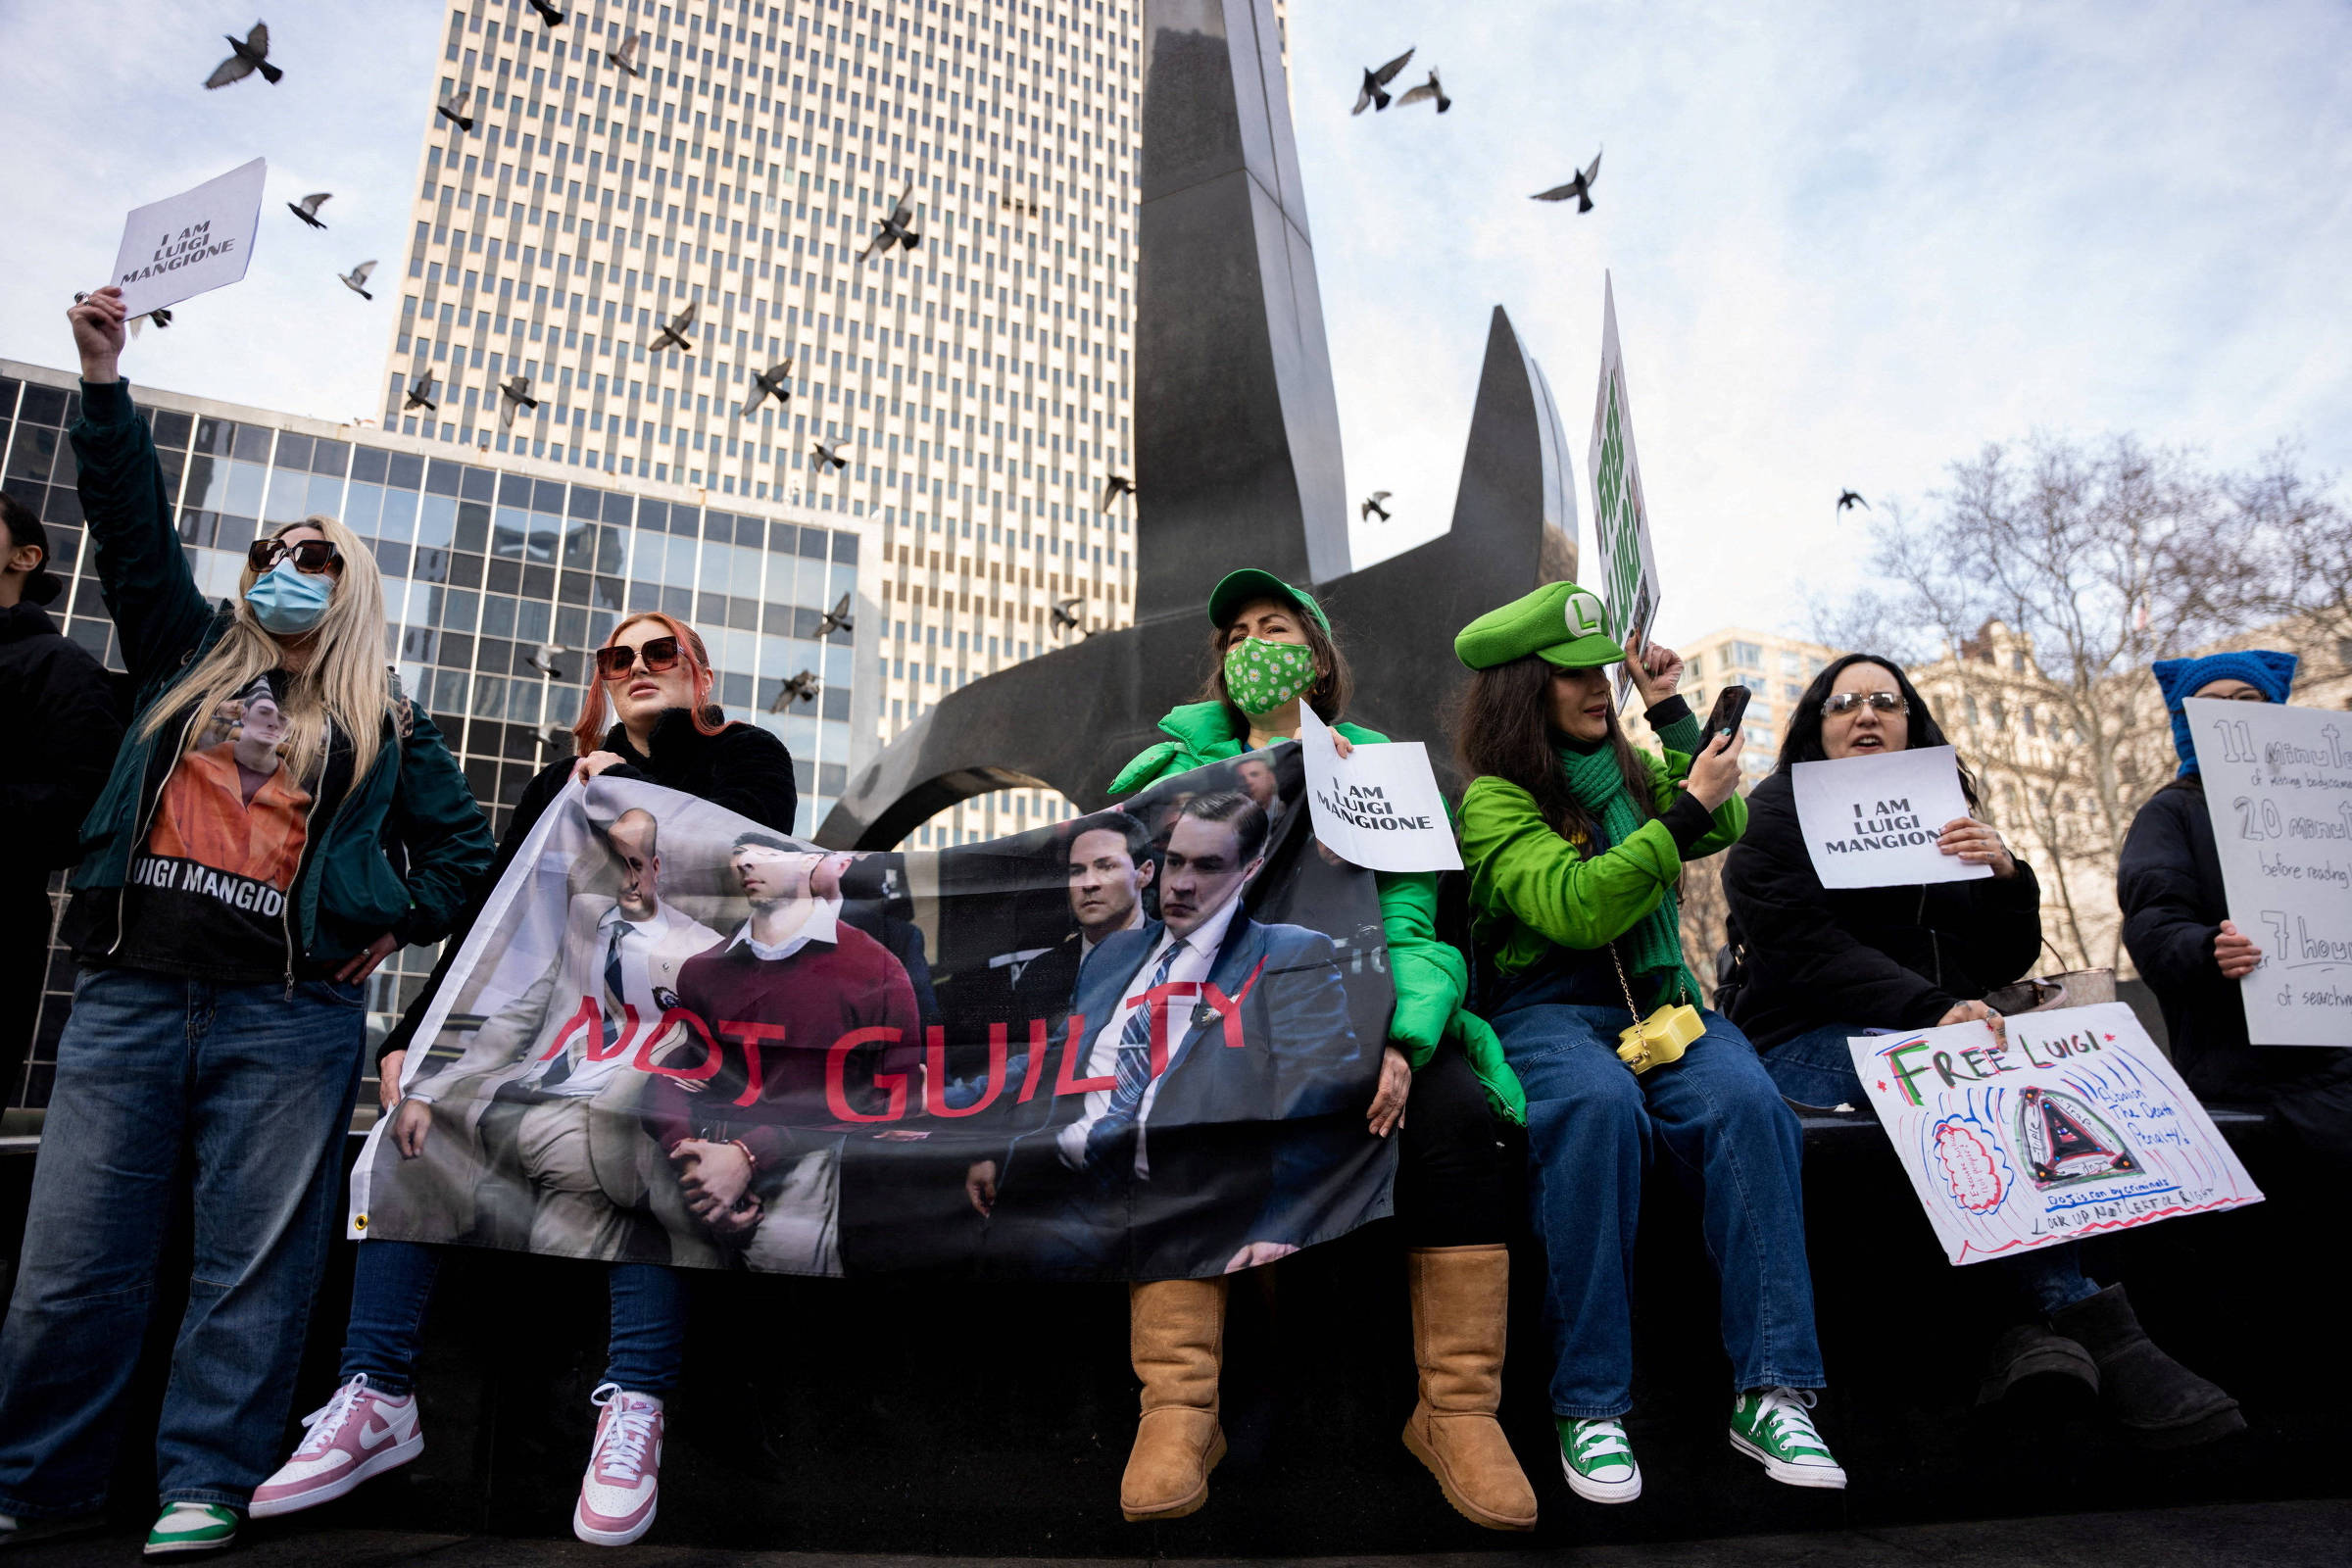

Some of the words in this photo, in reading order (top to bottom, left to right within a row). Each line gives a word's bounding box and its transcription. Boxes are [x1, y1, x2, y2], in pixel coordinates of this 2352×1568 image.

[153, 233, 210, 262] LUIGI
[161, 234, 170, 246] I
[177, 220, 211, 241] AM
[120, 238, 236, 287] MANGIONE
[1597, 368, 1625, 557] FREE
[1608, 473, 1642, 650] LUIGI
[1572, 600, 1596, 629] L
[2213, 719, 2257, 762] 11
[1333, 776, 1340, 791] I
[1349, 785, 1385, 800] AM
[2251, 767, 2262, 786] of
[1316, 790, 1434, 831] MANGIONE
[1333, 790, 1394, 815] LUIGI
[1853, 804, 1863, 818] I
[1875, 798, 1911, 816] AM
[2233, 796, 2282, 841] 20
[1853, 814, 1921, 835] LUIGI
[1825, 828, 1942, 855] MANGION
[2259, 851, 2302, 878] before
[2307, 859, 2349, 889] reading
[133, 858, 178, 888] UIGI
[182, 862, 286, 918] MANGIO
[2261, 910, 2289, 960] 7
[2278, 984, 2292, 1006] of
[538, 994, 784, 1108] NOT
[825, 954, 1269, 1125] GUILTY
[1881, 1039, 2022, 1106] FREE
[2019, 1030, 2101, 1068] LUIGI
[2110, 1187, 2123, 1200] by
[2123, 1178, 2170, 1195] criminals
